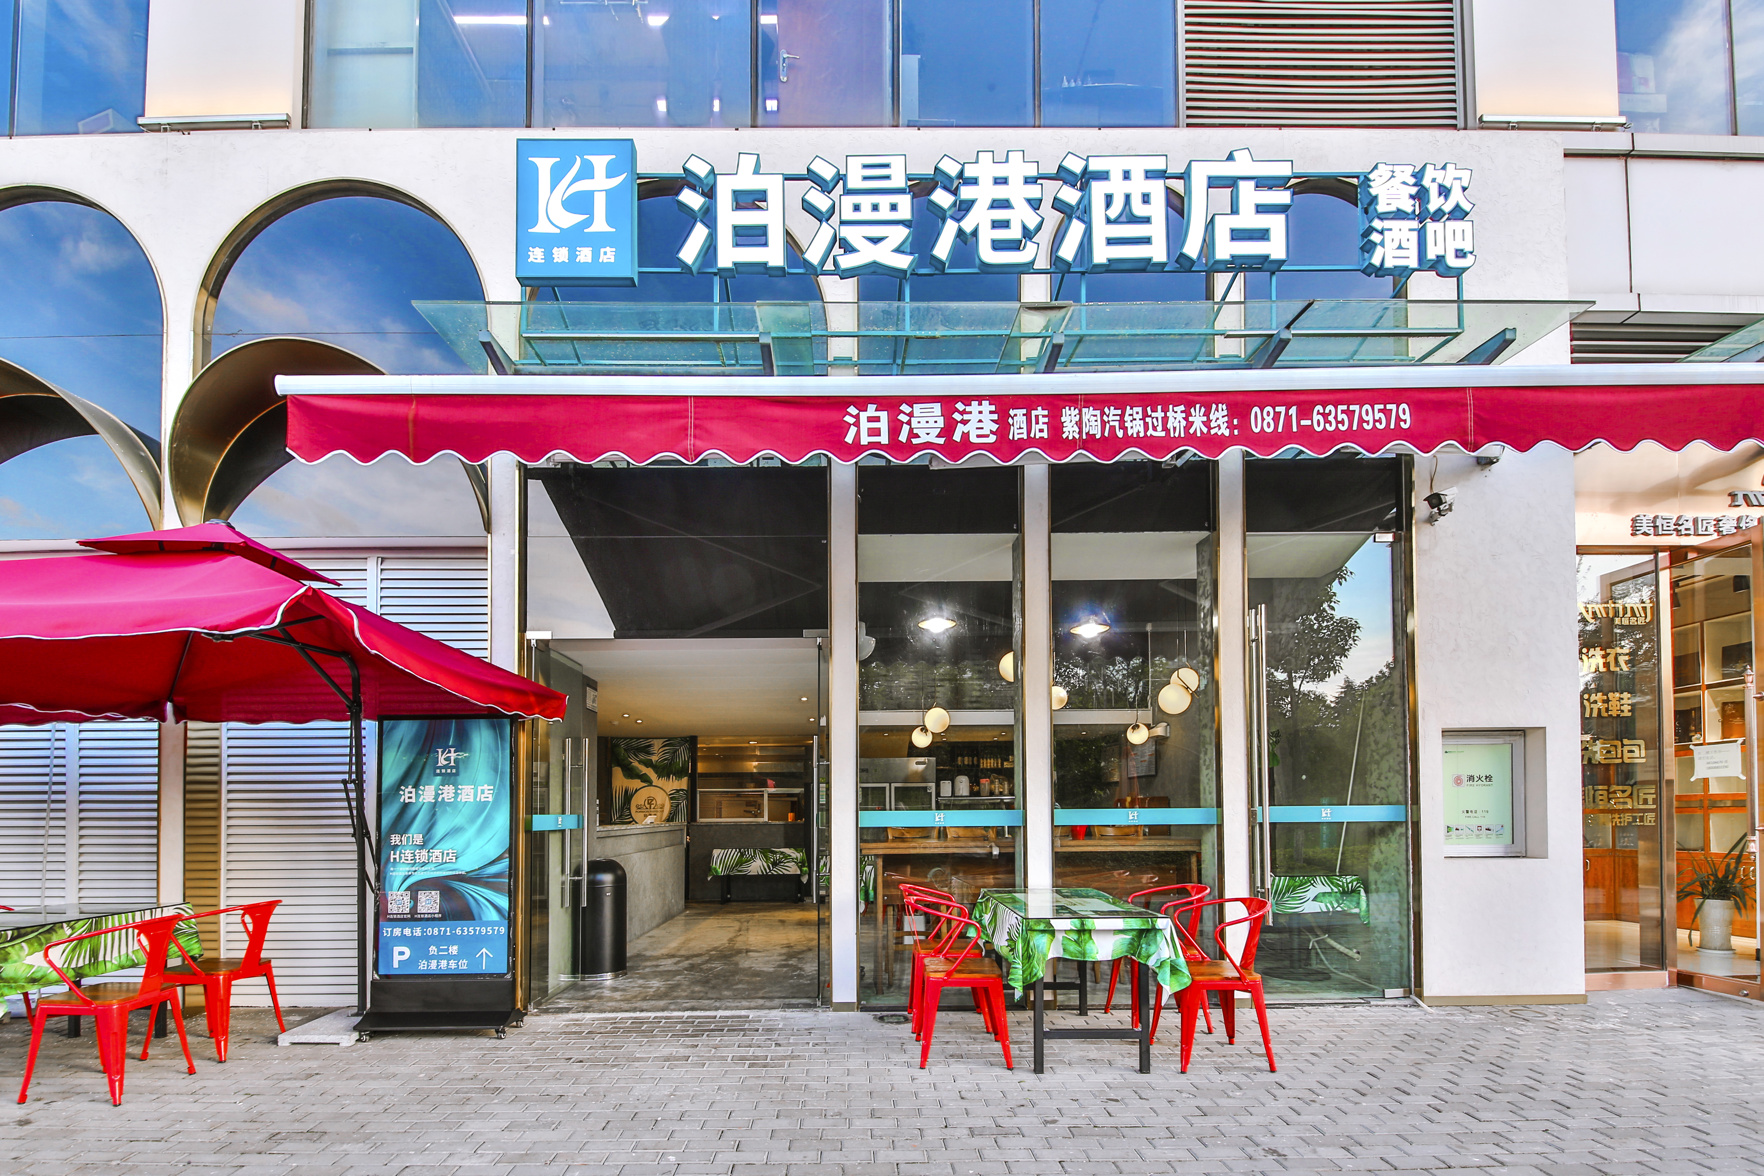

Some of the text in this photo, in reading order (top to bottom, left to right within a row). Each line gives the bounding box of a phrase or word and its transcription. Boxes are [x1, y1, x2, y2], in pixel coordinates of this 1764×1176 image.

[1365, 162, 1475, 215] 餐饮
[676, 148, 1293, 276] 泊漫港酒店
[528, 246, 616, 263] 连锁酒店
[1364, 218, 1476, 274] 酒吧
[1581, 646, 1631, 672] 洗衣
[1583, 692, 1632, 717] 洗鞋
[1466, 774, 1493, 783] 消火栓
[399, 784, 494, 803] 泊漫港酒店
[390, 834, 424, 846] 我们是
[390, 849, 457, 864] H连锁酒店
[393, 946, 411, 968] P
[428, 945, 459, 955] 负二楼
[418, 959, 468, 970] 泊漫港车位
